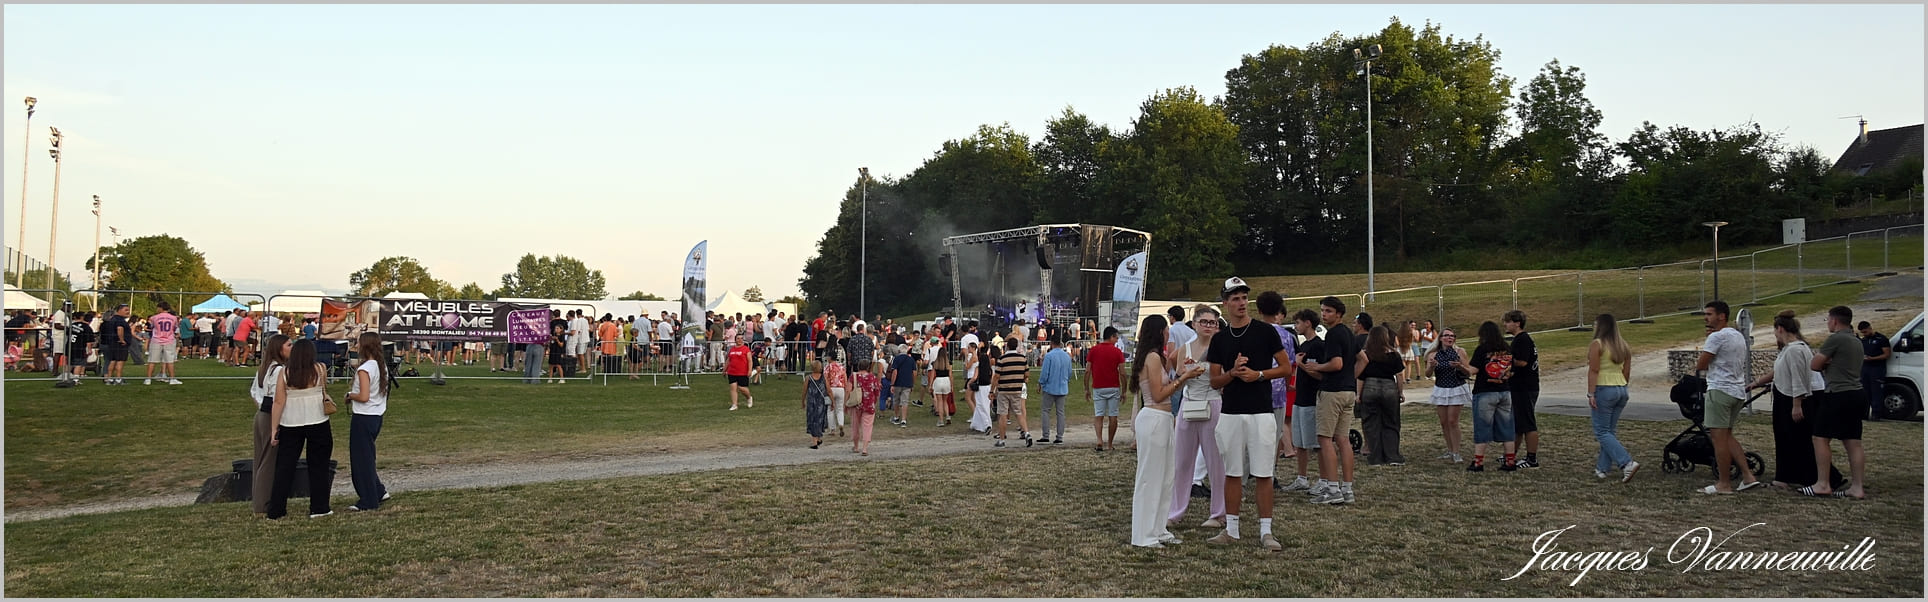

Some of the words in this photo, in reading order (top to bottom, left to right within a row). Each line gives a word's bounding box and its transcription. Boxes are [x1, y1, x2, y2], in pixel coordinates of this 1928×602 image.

[394, 301, 494, 314] MEUBLES
[157, 320, 171, 332] 10
[386, 314, 421, 326] AT'
[425, 313, 493, 329] HOME
